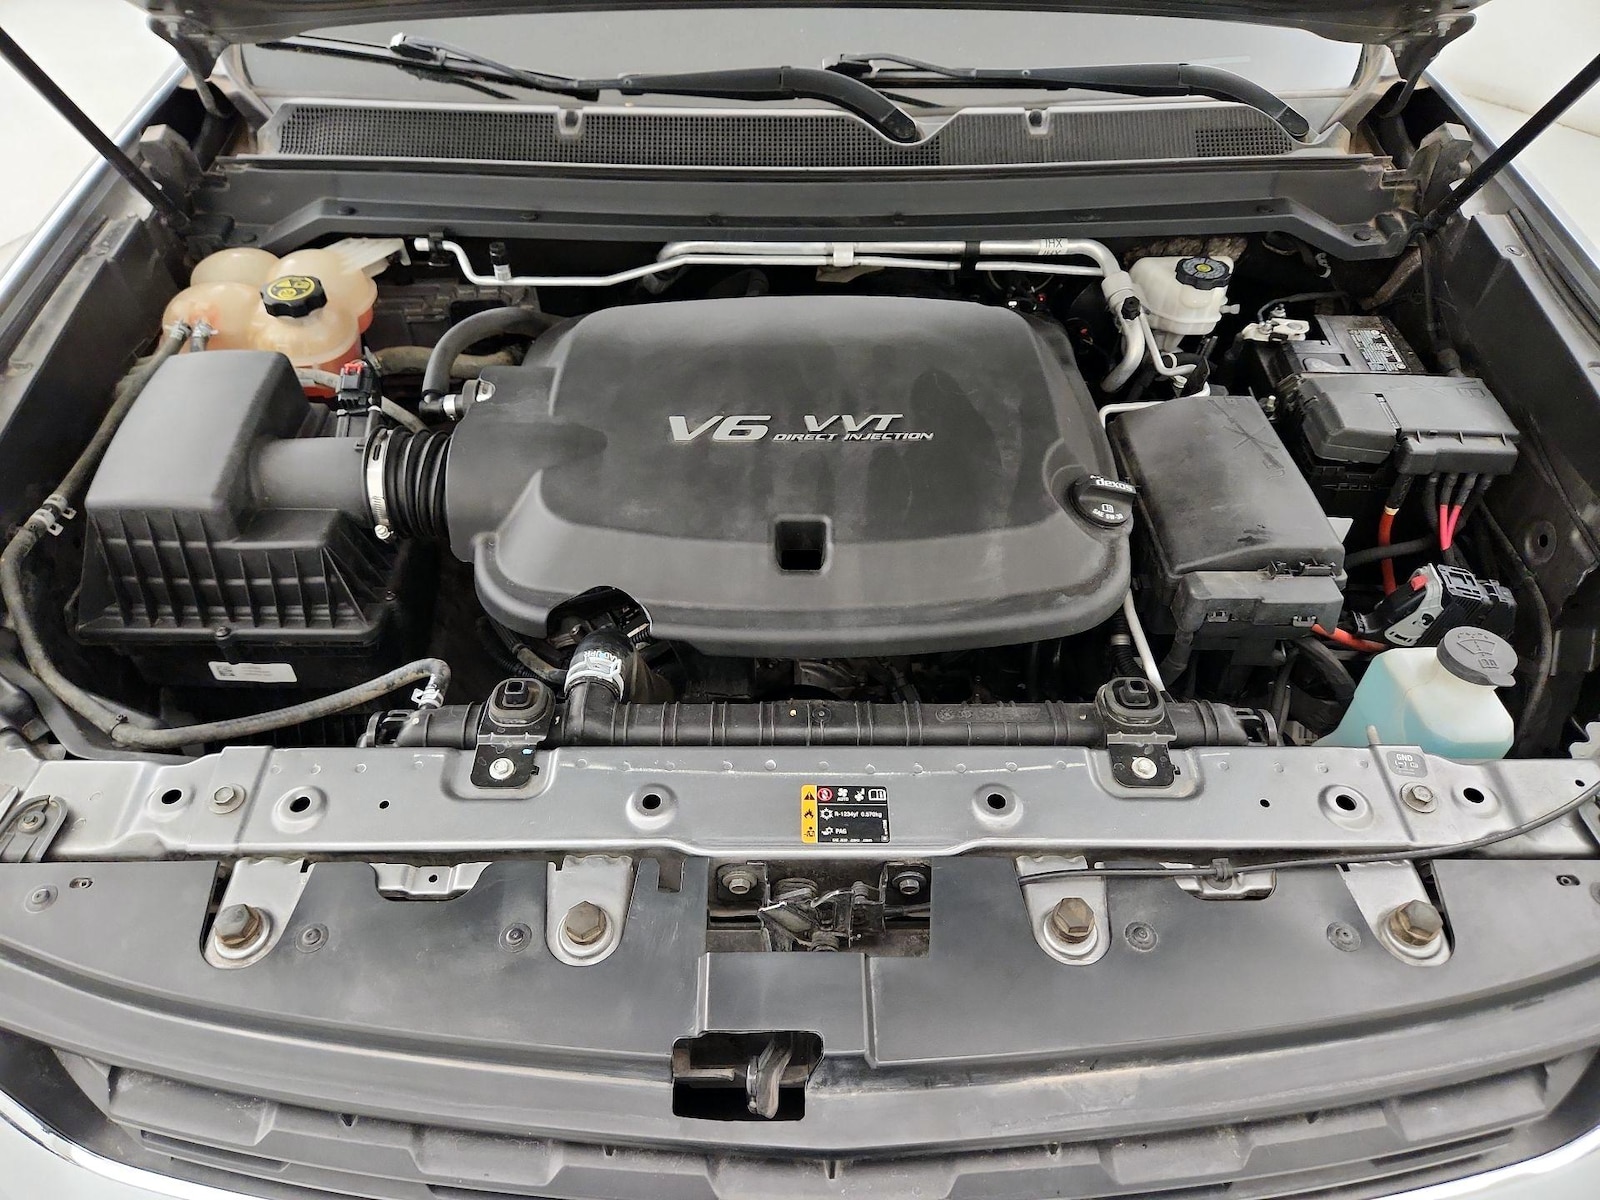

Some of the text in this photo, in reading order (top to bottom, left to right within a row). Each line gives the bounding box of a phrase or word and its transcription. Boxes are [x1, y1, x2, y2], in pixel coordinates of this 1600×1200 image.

[668, 414, 904, 442] V6 VVT
[773, 432, 934, 442] DIRECT INJECTION
[1095, 478, 1133, 491] dexos
[1396, 753, 1413, 762] GND
